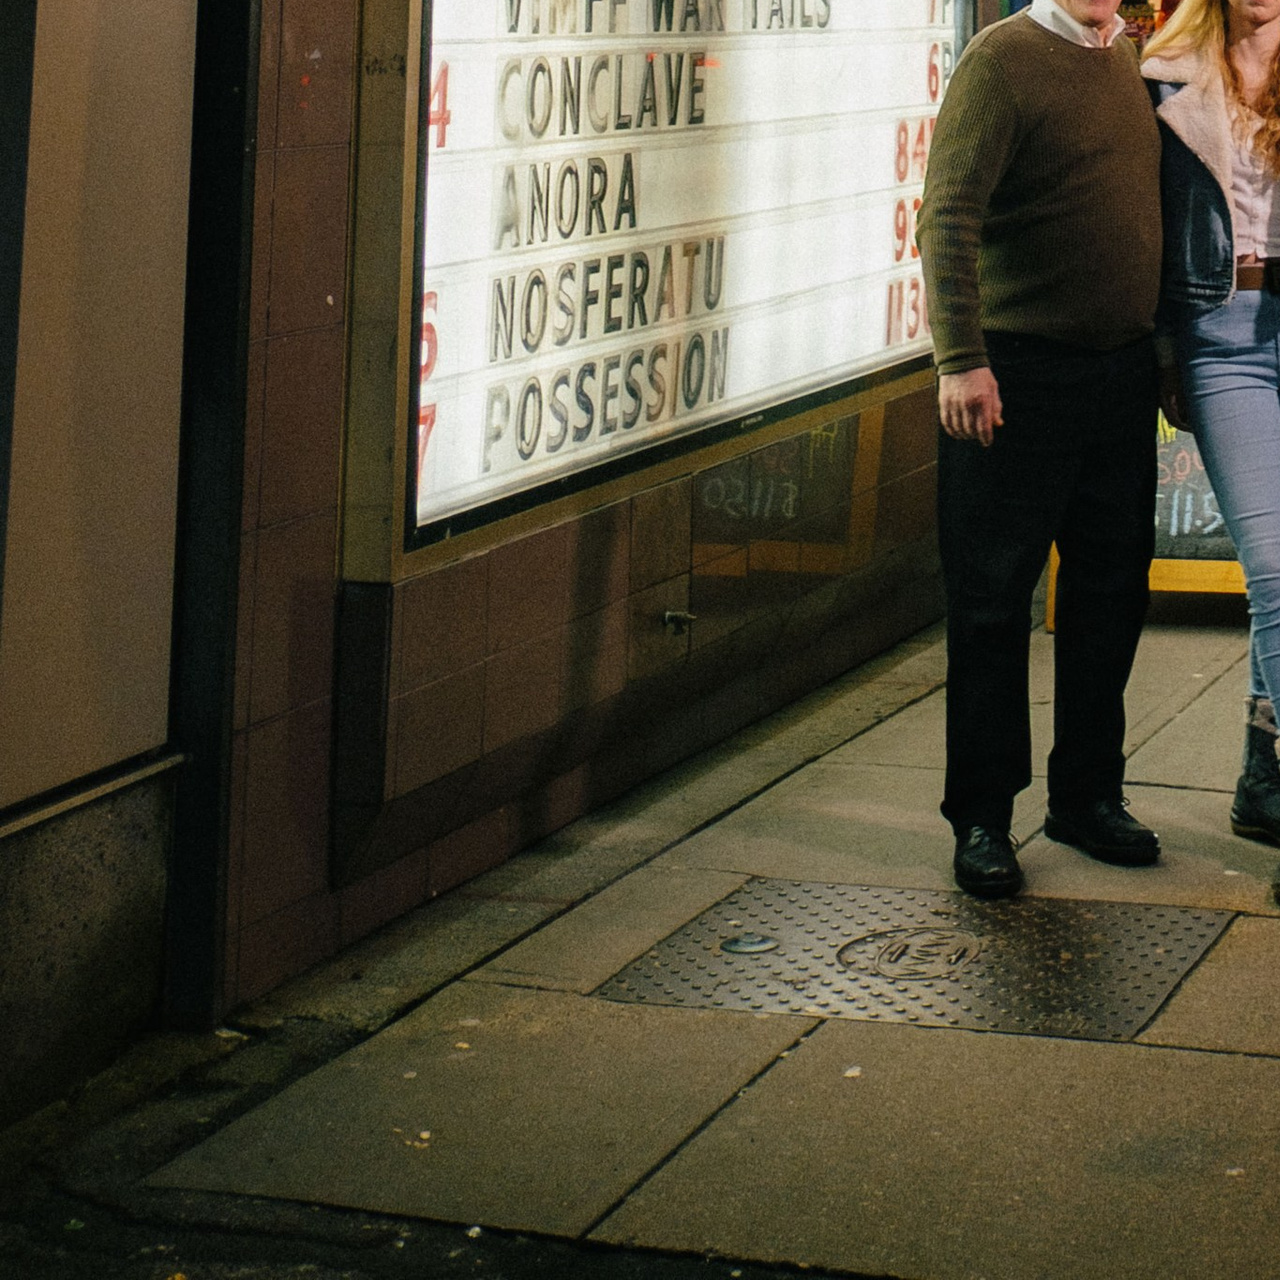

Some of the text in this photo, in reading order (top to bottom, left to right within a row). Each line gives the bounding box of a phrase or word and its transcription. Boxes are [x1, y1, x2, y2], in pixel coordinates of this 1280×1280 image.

[500, 51, 706, 141] CONCLAVE
[495, 117, 937, 249] ANORA 84
[489, 238, 726, 353] NOSFERATU
[482, 326, 730, 474] POSSESSION
